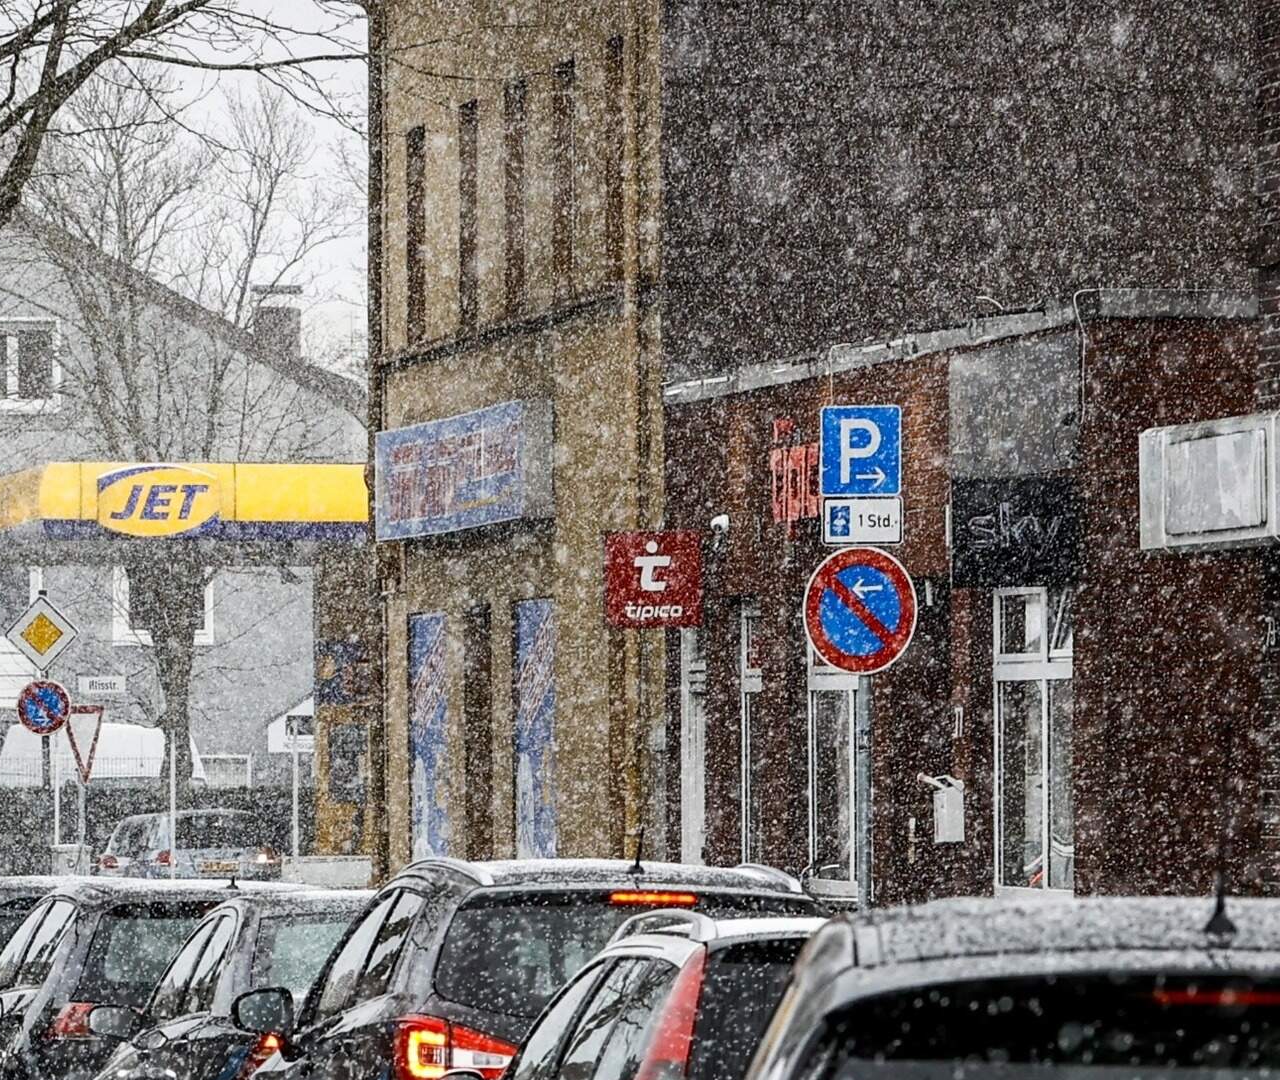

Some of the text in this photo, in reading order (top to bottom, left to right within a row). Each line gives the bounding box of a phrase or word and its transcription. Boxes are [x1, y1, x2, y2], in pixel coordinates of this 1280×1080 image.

[840, 418, 881, 484] P
[110, 484, 209, 519] JET
[624, 602, 684, 620] tipico
